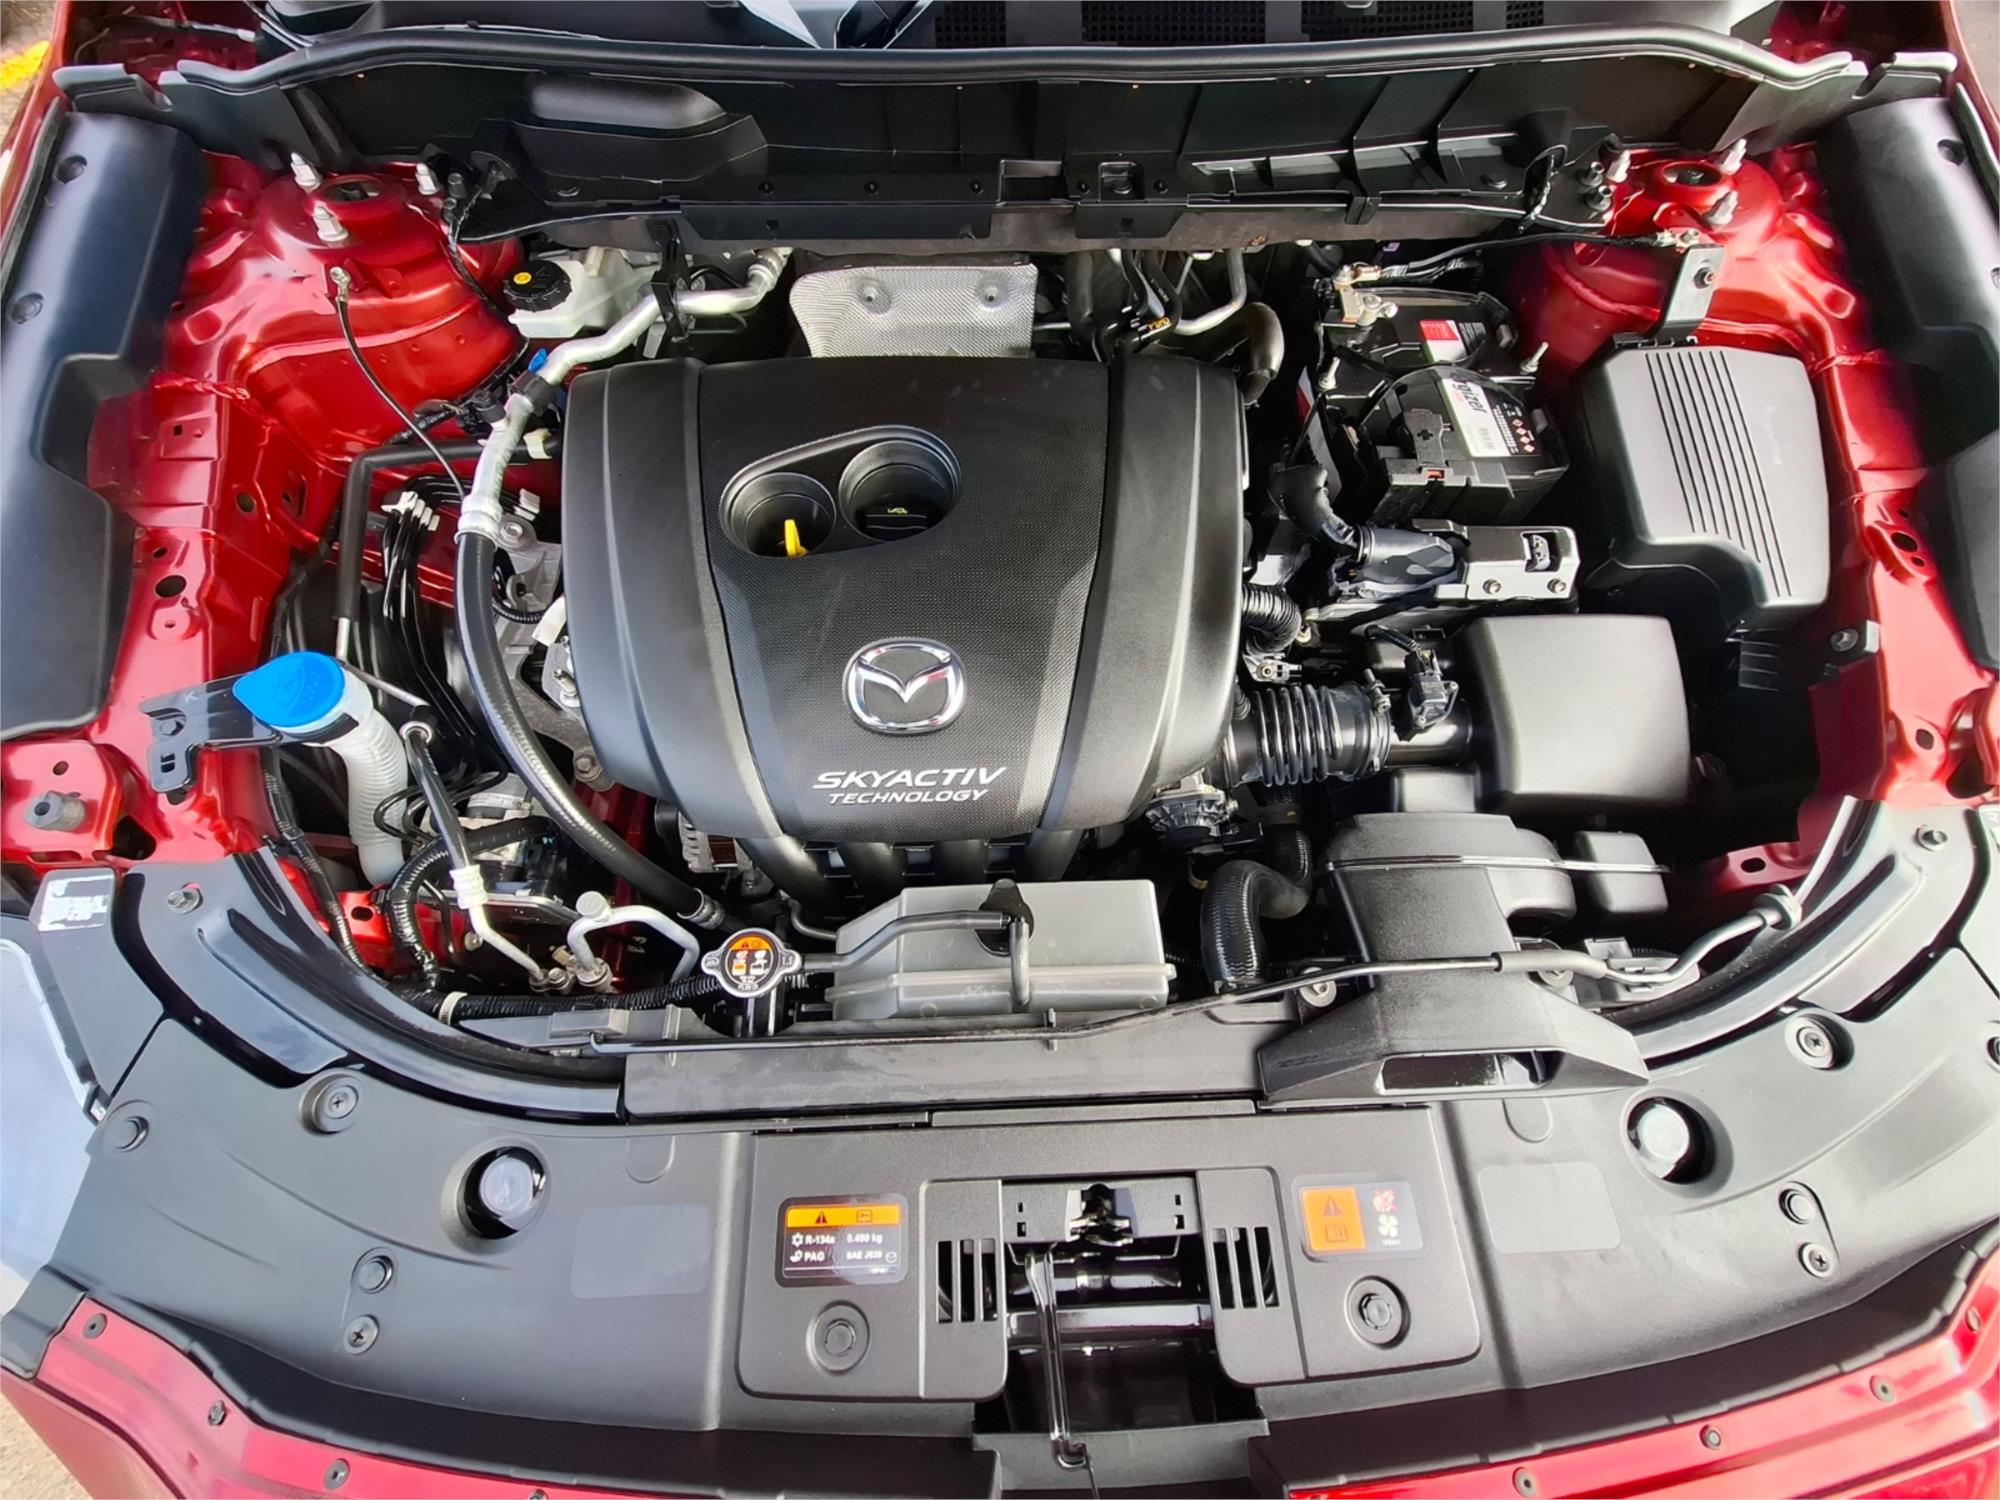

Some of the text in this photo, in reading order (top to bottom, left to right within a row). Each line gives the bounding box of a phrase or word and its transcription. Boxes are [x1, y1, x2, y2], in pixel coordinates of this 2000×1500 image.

[812, 766, 1007, 789] SKYACTIV
[829, 789, 988, 805] TECHNOLOGY
[805, 1234, 836, 1245] R-134a
[871, 1232, 883, 1245] kg
[804, 1251, 825, 1262] PAG
